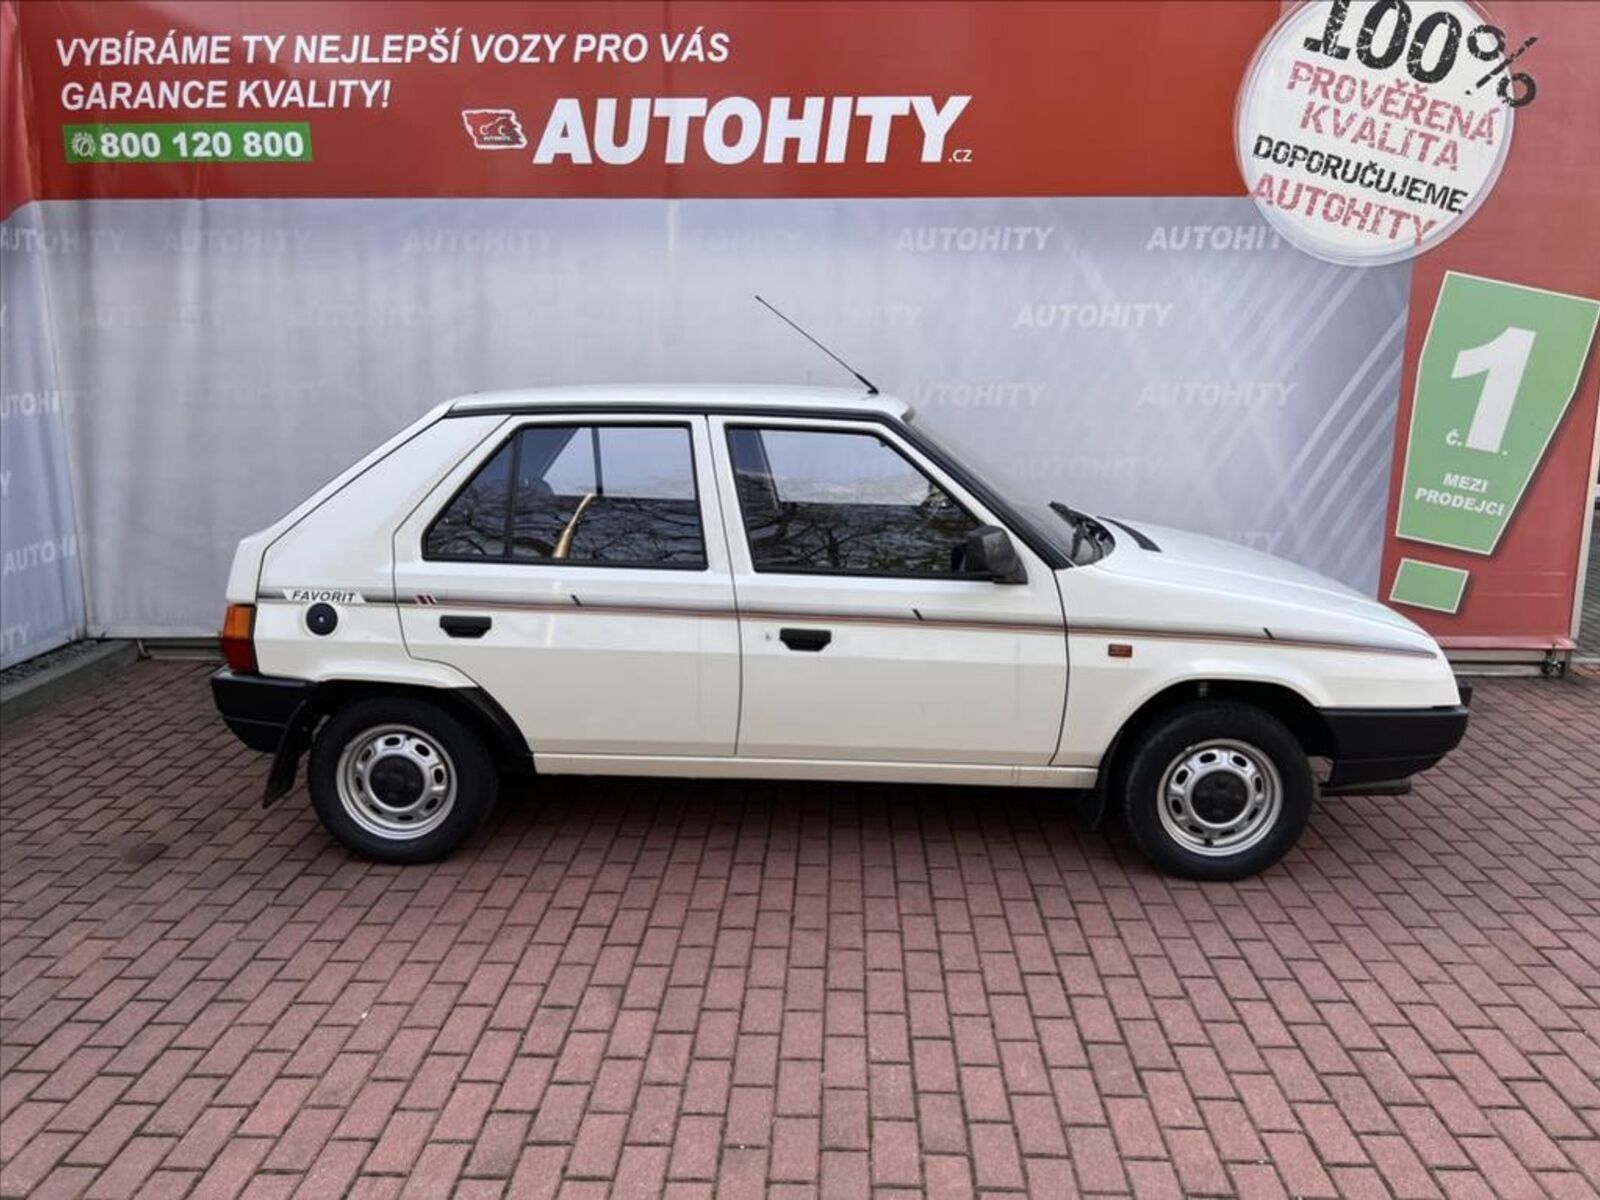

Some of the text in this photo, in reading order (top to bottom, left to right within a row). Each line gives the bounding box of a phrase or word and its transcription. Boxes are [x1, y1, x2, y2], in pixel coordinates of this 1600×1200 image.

[56, 26, 730, 66] VYBÍRÁME TY NEJLEPŠÍ VOZY PRO VÁS
[1303, 0, 1540, 108] 100%
[61, 79, 391, 111] GARANCE KVALITY!
[1286, 60, 1500, 146] PROVĚŘENÁ
[100, 131, 304, 158] 800 120 800
[532, 95, 972, 165] AUTOHITY
[1299, 101, 1461, 172] KVALITA
[1253, 134, 1469, 215] DOPORUČUJEME
[1251, 172, 1440, 247] AUTOHITY
[897, 226, 1054, 252] AUTOHITY
[1013, 303, 1174, 329] AUTOHITY
[1137, 382, 1297, 407] AUTOHITY
[1443, 473, 1489, 494] MEZI
[1415, 487, 1505, 516] PRODEJCI
[292, 589, 357, 603] FAVORIT
